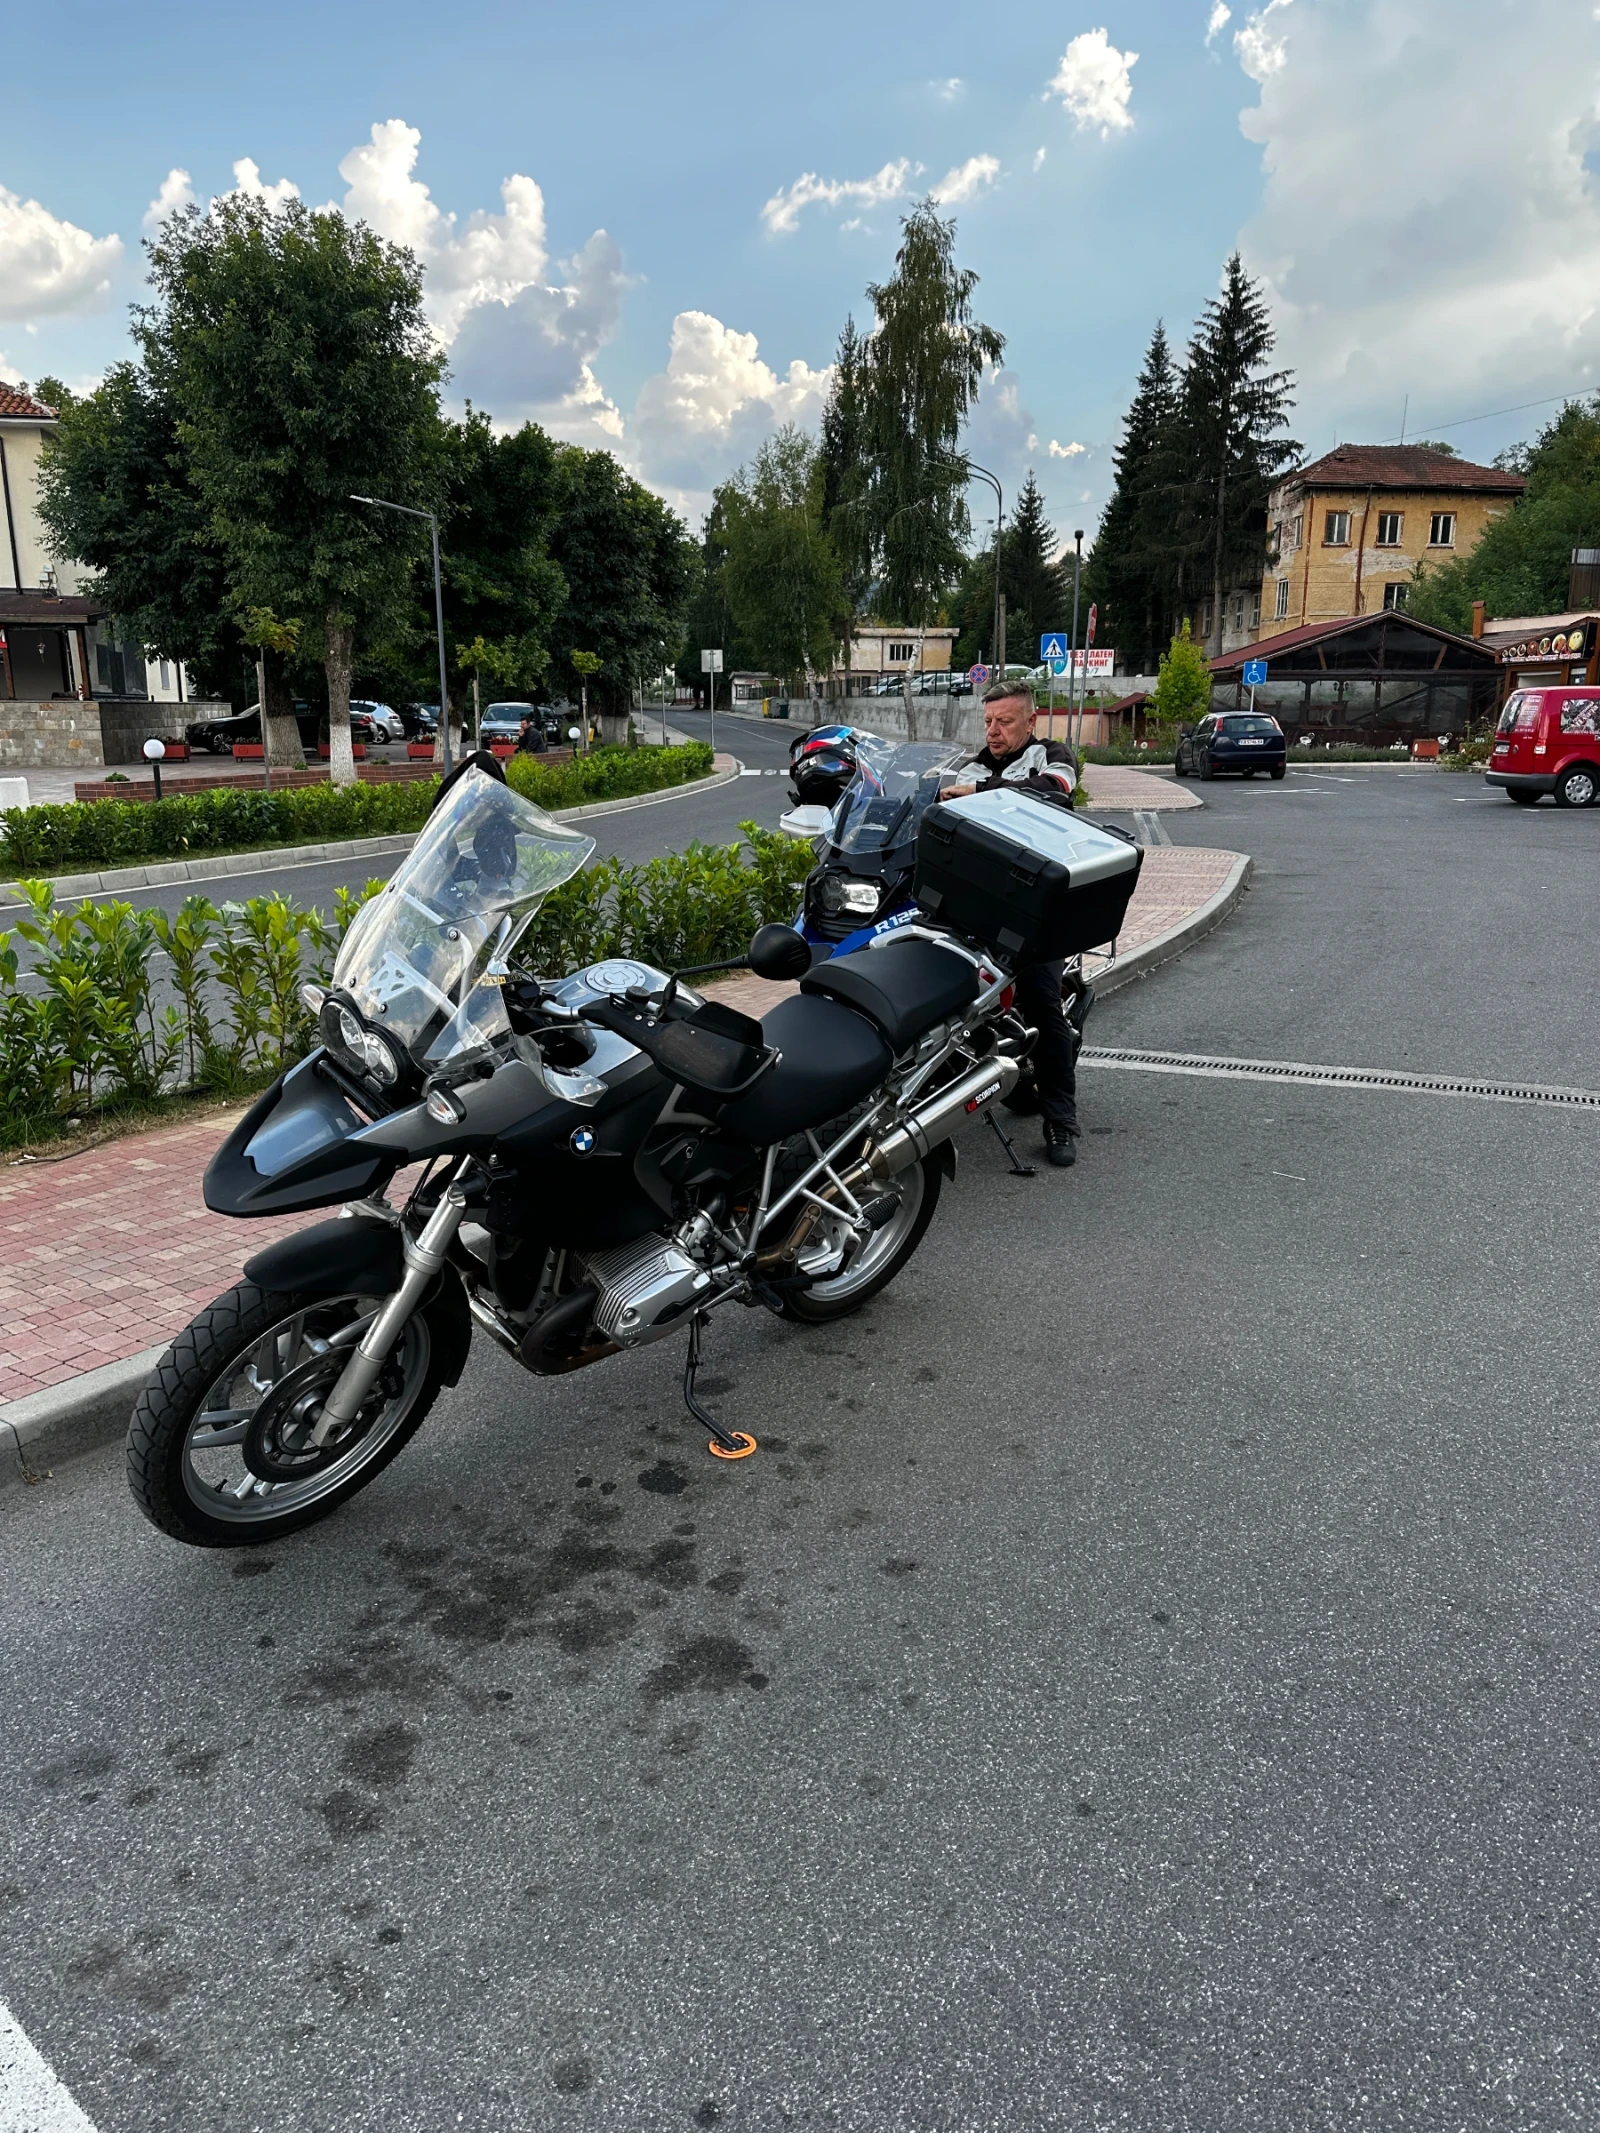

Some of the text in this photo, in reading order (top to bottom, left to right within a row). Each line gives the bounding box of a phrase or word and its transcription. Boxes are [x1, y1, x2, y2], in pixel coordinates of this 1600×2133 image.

[1070, 650, 1113, 659] ЕЗЛАТЕН
[1074, 659, 1108, 667] ПАКИНГ
[975, 1081, 1001, 1104] SCORPION
